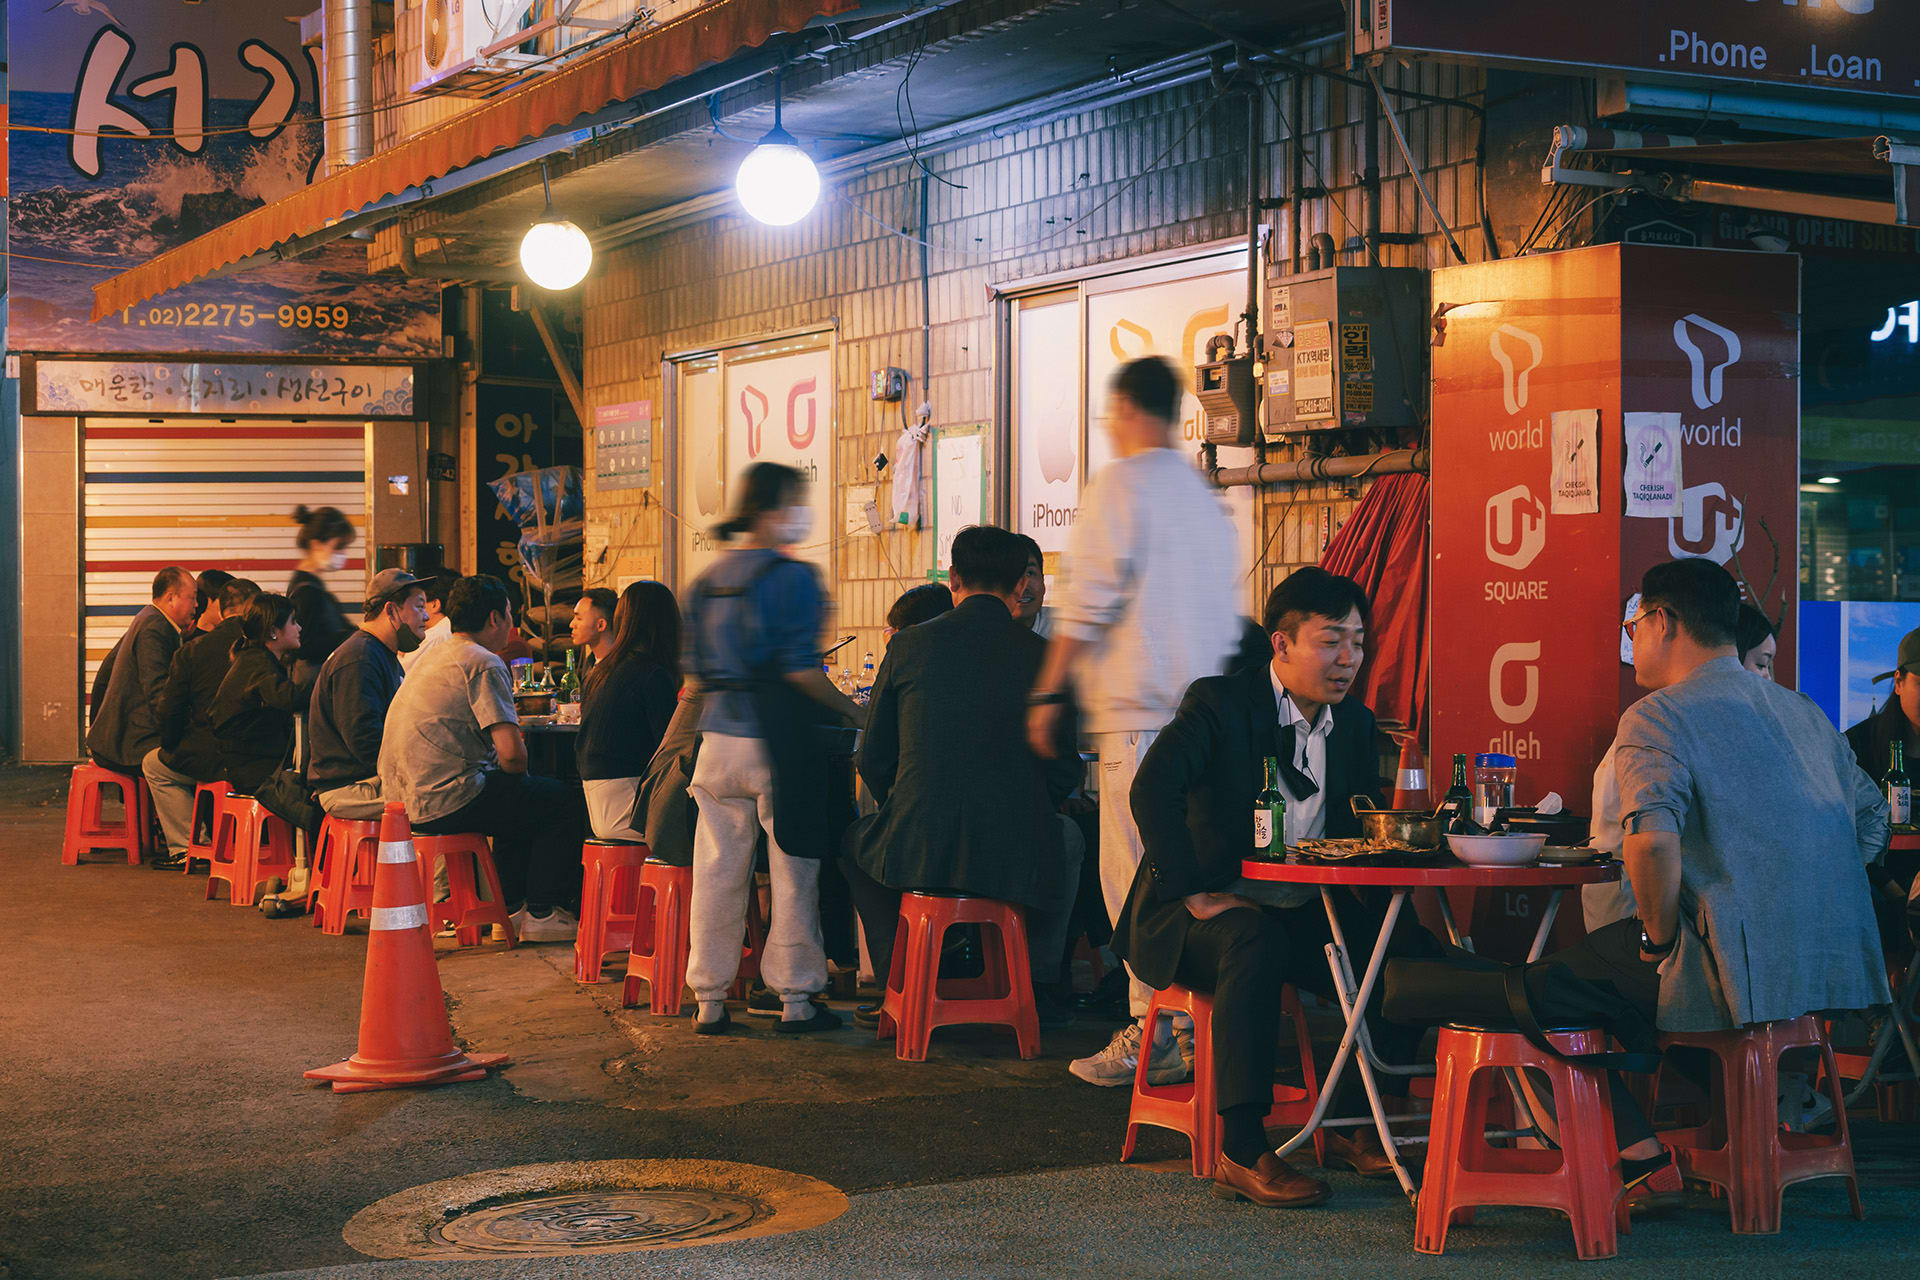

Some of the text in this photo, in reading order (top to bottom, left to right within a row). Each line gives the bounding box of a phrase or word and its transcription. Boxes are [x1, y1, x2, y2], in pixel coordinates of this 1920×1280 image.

[1796, 218, 1854, 249] OPEN!
[1860, 225, 1908, 251] SALE
[1488, 419, 1544, 453] world
[1484, 580, 1548, 603] SQUARE
[1504, 891, 1529, 918] LG
